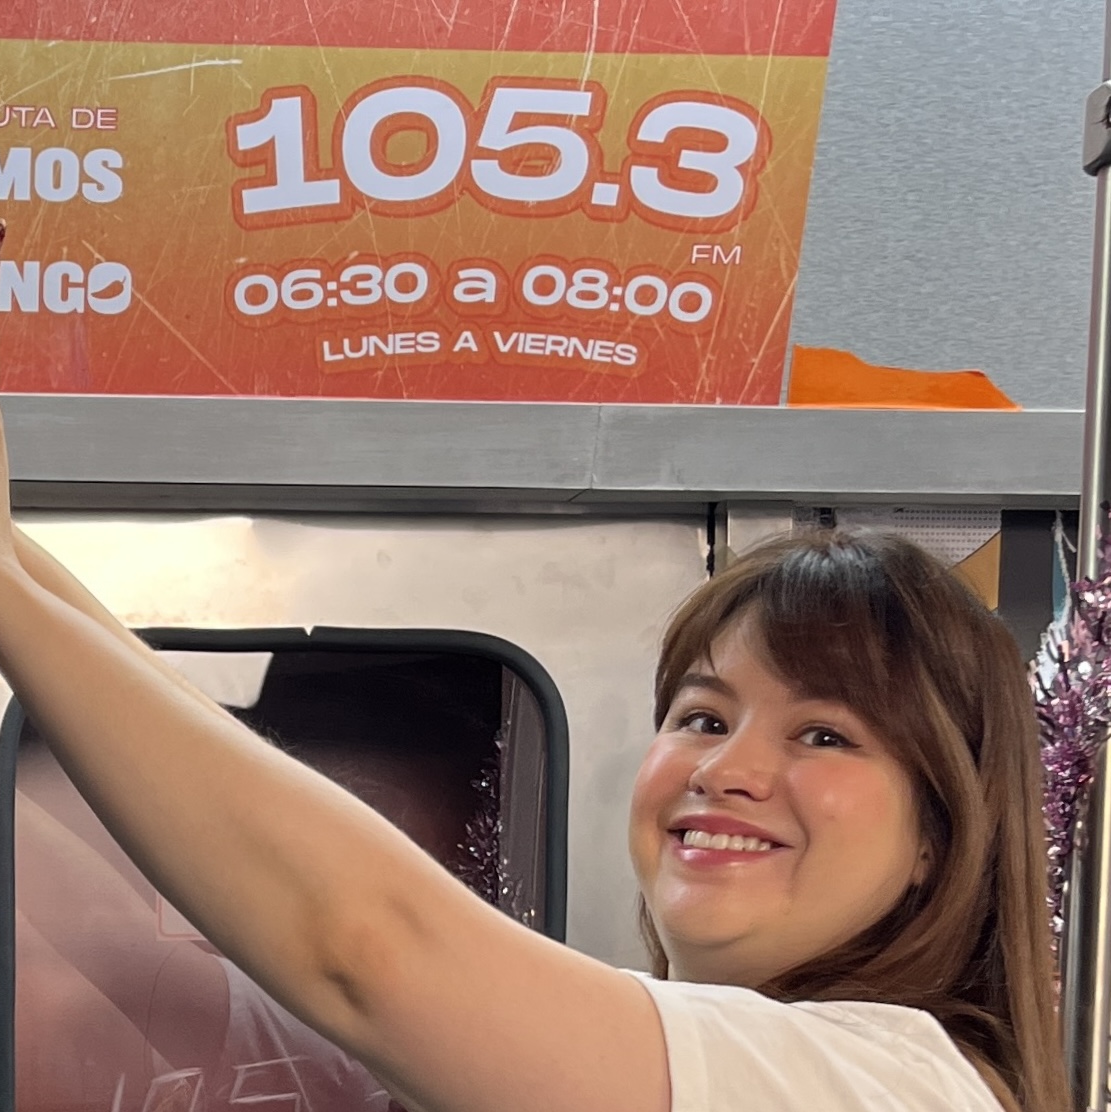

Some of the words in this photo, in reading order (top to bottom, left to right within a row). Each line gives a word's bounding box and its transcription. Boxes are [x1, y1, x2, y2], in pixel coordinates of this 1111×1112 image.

[72, 107, 118, 129] DE
[236, 86, 758, 218] 105.3
[690, 244, 742, 265] FM
[233, 262, 428, 315] 06:30
[453, 267, 497, 303] a
[522, 264, 713, 323] 08:00
[322, 331, 441, 362] LUNES
[453, 330, 478, 352] A
[493, 330, 639, 366] VIERNES
